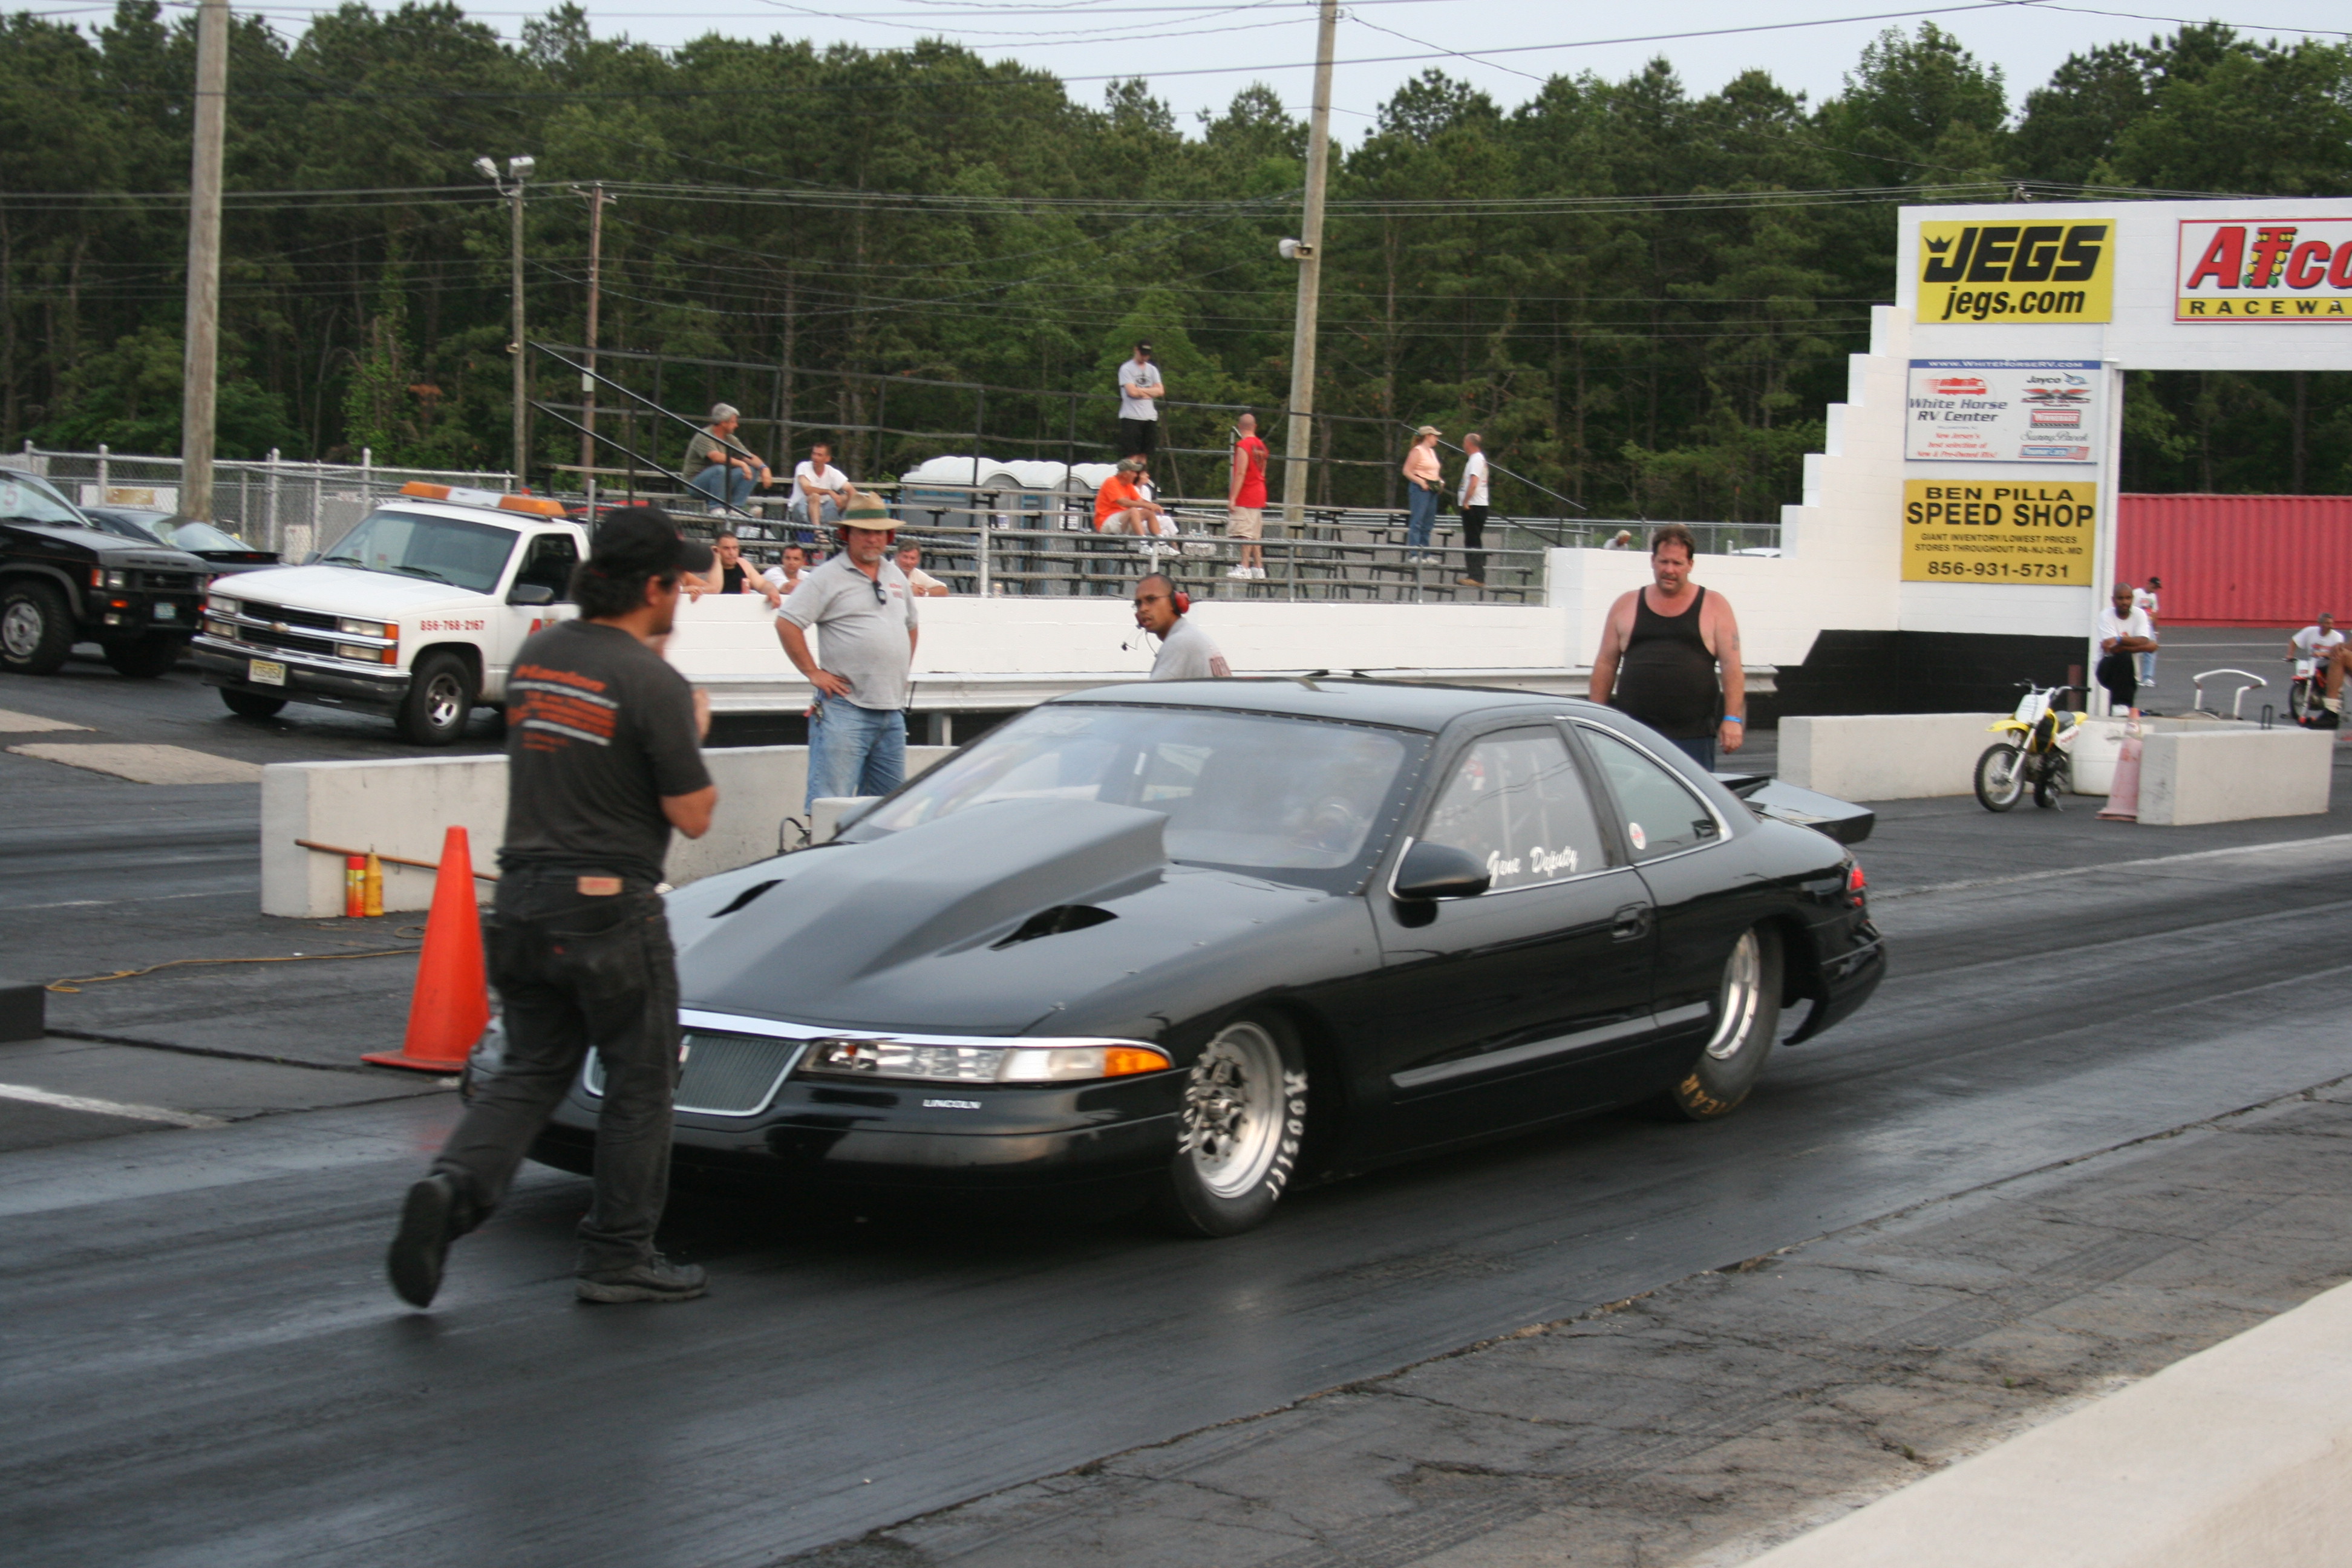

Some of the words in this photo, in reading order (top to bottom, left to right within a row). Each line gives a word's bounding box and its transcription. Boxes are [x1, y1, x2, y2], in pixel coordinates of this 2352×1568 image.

[1923, 226, 2108, 283] JEGS
[1941, 286, 2085, 321] jegs.com
[2027, 376, 2061, 385] Jayco
[1909, 398, 1955, 409] White
[1960, 399, 2008, 410] Horse
[1917, 411, 1939, 421] RV
[1944, 411, 1998, 422] Center
[1926, 487, 1982, 500] BEN
[1994, 488, 2074, 501] PILLA
[1907, 502, 2002, 525] SPEED
[2013, 503, 2093, 527] SHOP
[2045, 535, 2077, 544] PRICES
[1915, 543, 1950, 552] STORES
[1953, 544, 2014, 554] THROUGHOUT
[1929, 561, 2068, 577] 856-931-5731
[421, 620, 485, 630] 856-768-2167
[923, 1099, 981, 1109] LINCOLN
